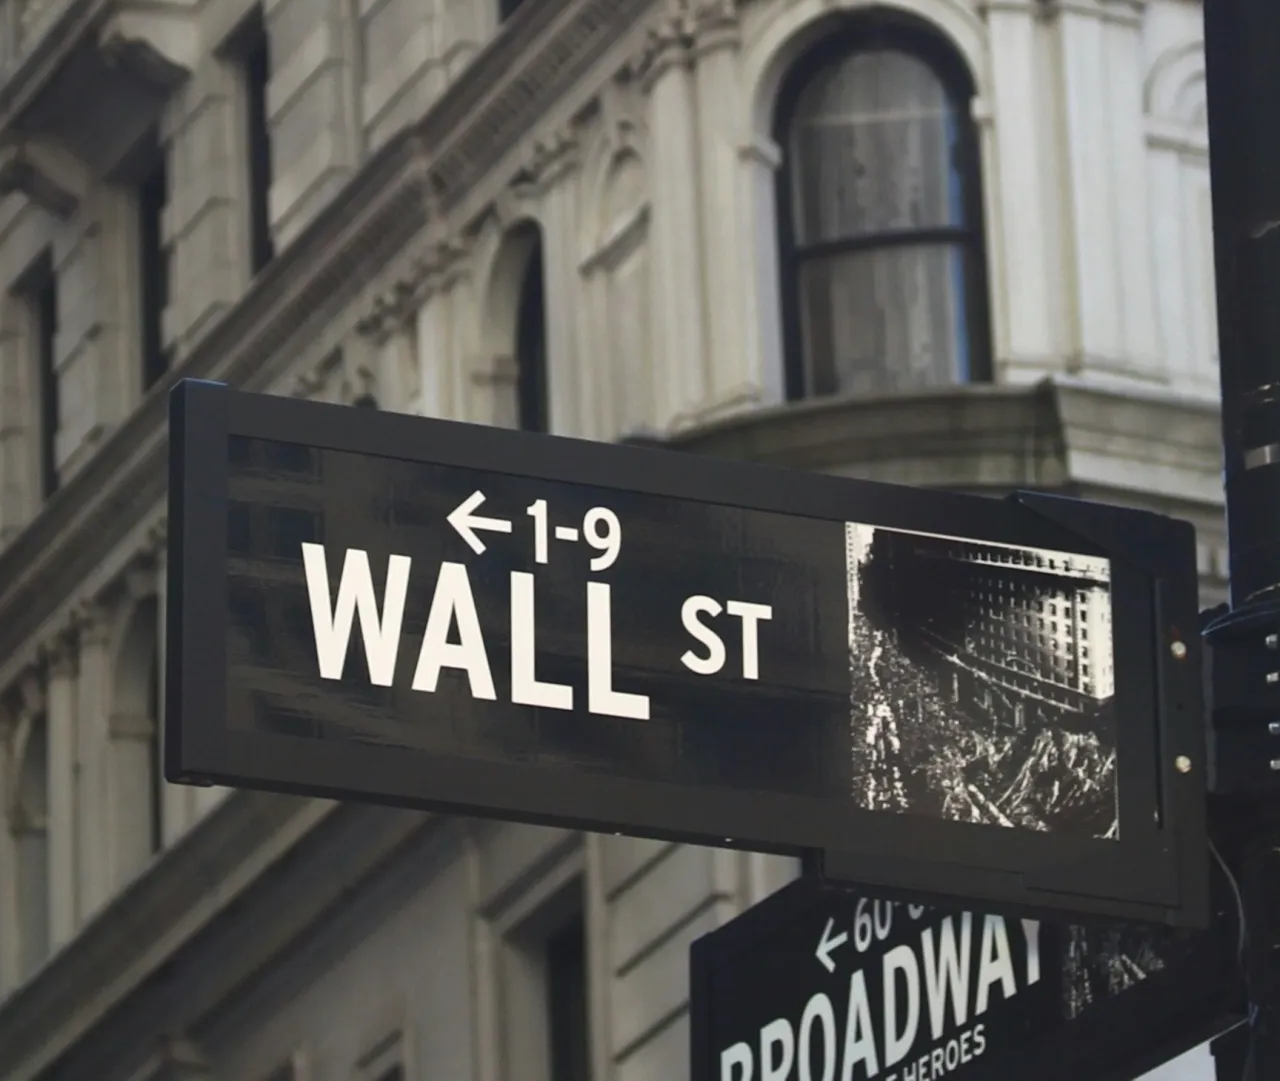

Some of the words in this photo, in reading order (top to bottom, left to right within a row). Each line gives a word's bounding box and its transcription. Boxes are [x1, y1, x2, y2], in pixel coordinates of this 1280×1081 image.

[526, 497, 623, 573] 1-9
[301, 541, 651, 721] WALL
[680, 595, 774, 681] ST
